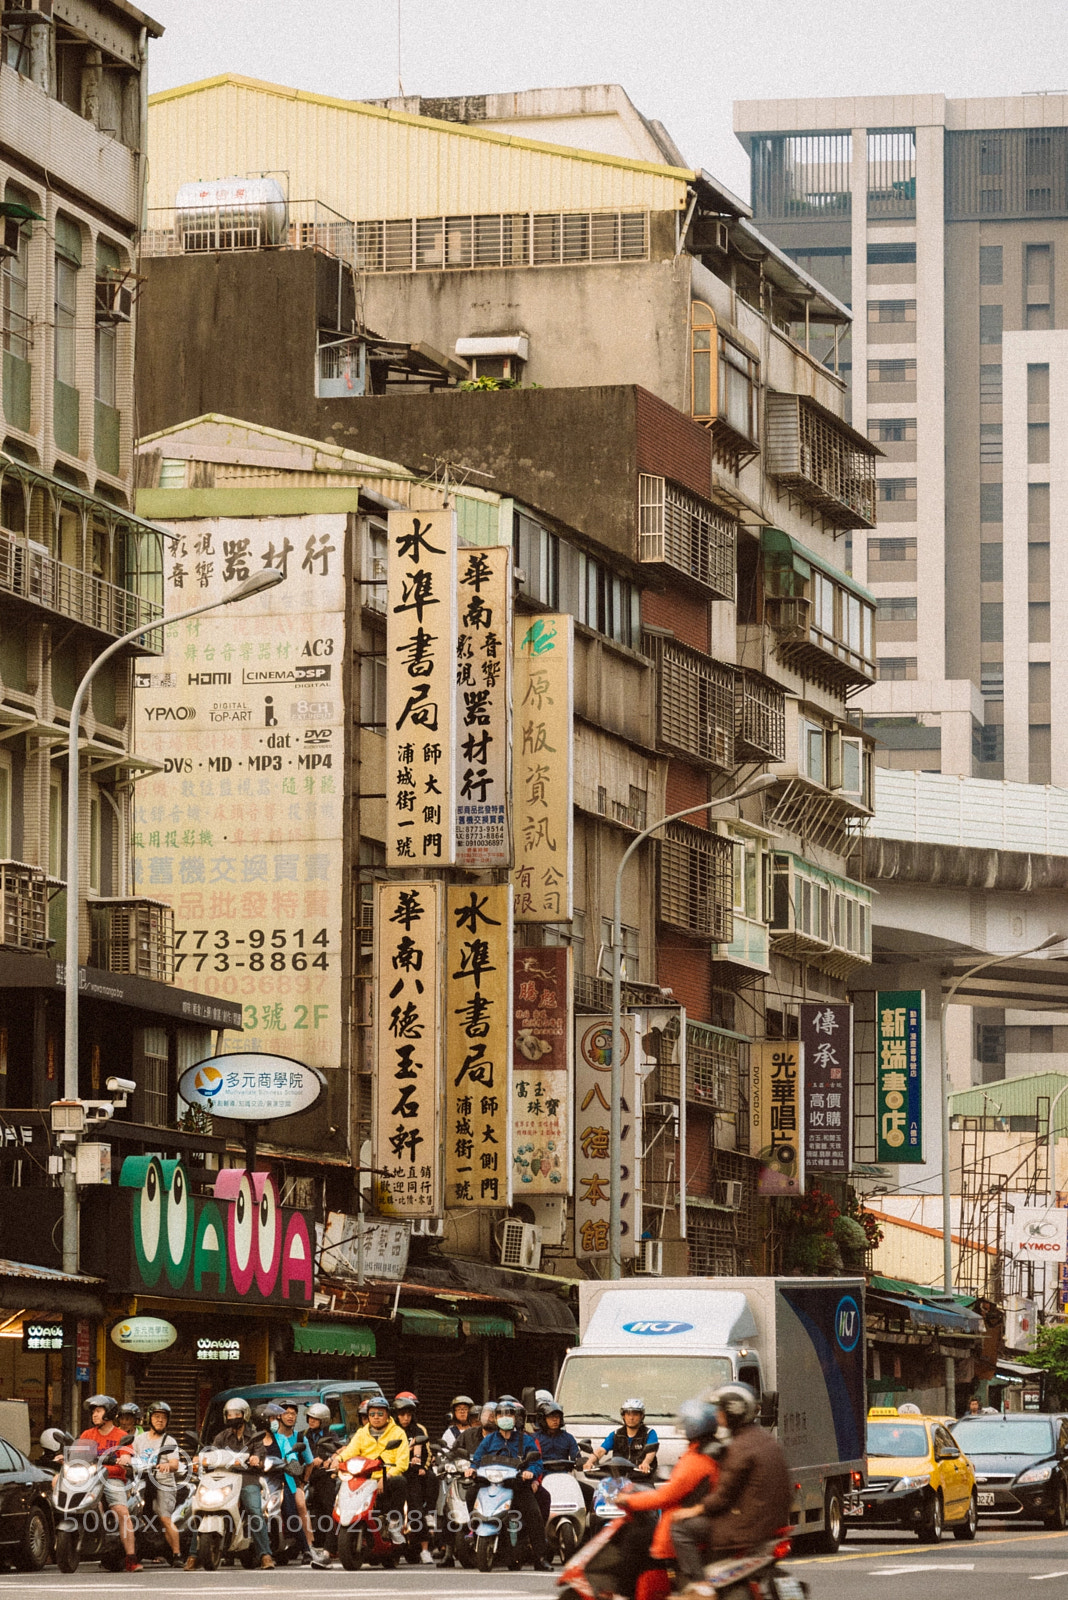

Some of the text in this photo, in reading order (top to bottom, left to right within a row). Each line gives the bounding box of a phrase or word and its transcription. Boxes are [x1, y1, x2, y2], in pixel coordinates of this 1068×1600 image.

[394, 518, 446, 731] 水準書局
[301, 638, 335, 658] AC3
[247, 754, 283, 772] MP3
[297, 753, 333, 771] MP4
[422, 743, 442, 858] 師大側門
[452, 892, 502, 1088] 水準書局
[293, 1004, 329, 1030] 2F
[226, 1071, 304, 1089] 多元商學院
[769, 1053, 797, 1157] 光華唱片
[809, 1093, 841, 1108] 高價
[809, 1111, 841, 1127] 收購
[480, 1096, 499, 1201] 師大側門
[1019, 1242, 1061, 1252] KYMCO
